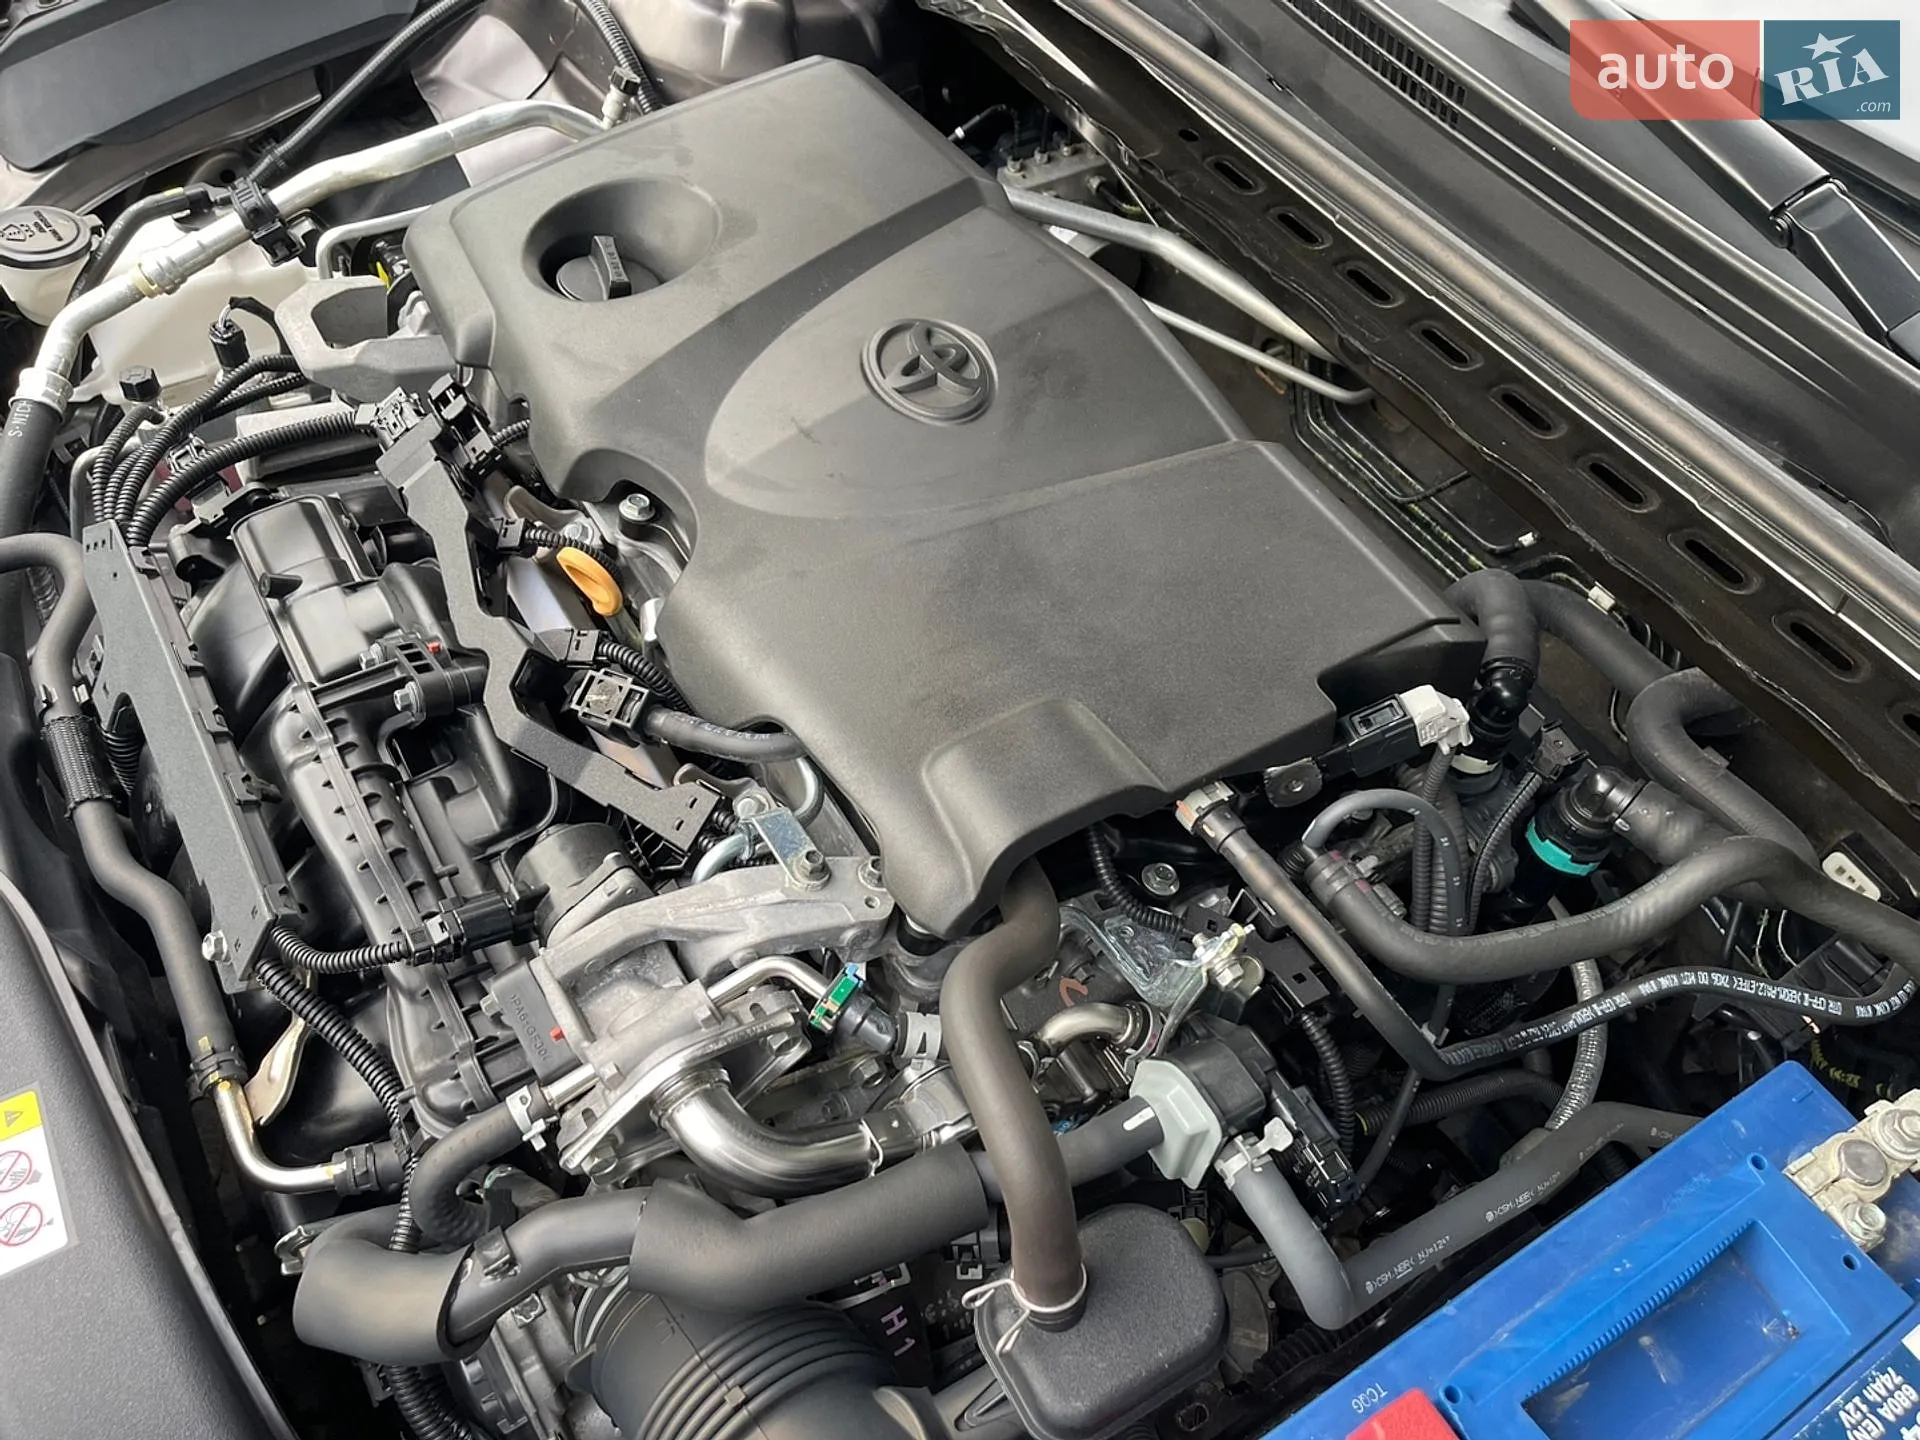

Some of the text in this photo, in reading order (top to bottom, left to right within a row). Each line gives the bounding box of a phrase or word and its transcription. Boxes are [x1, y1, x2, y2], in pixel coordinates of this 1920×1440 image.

[1862, 1366, 1904, 1403] 74Ah
[1876, 1383, 1919, 1423] 680A
[1838, 1395, 1870, 1430] 12V
